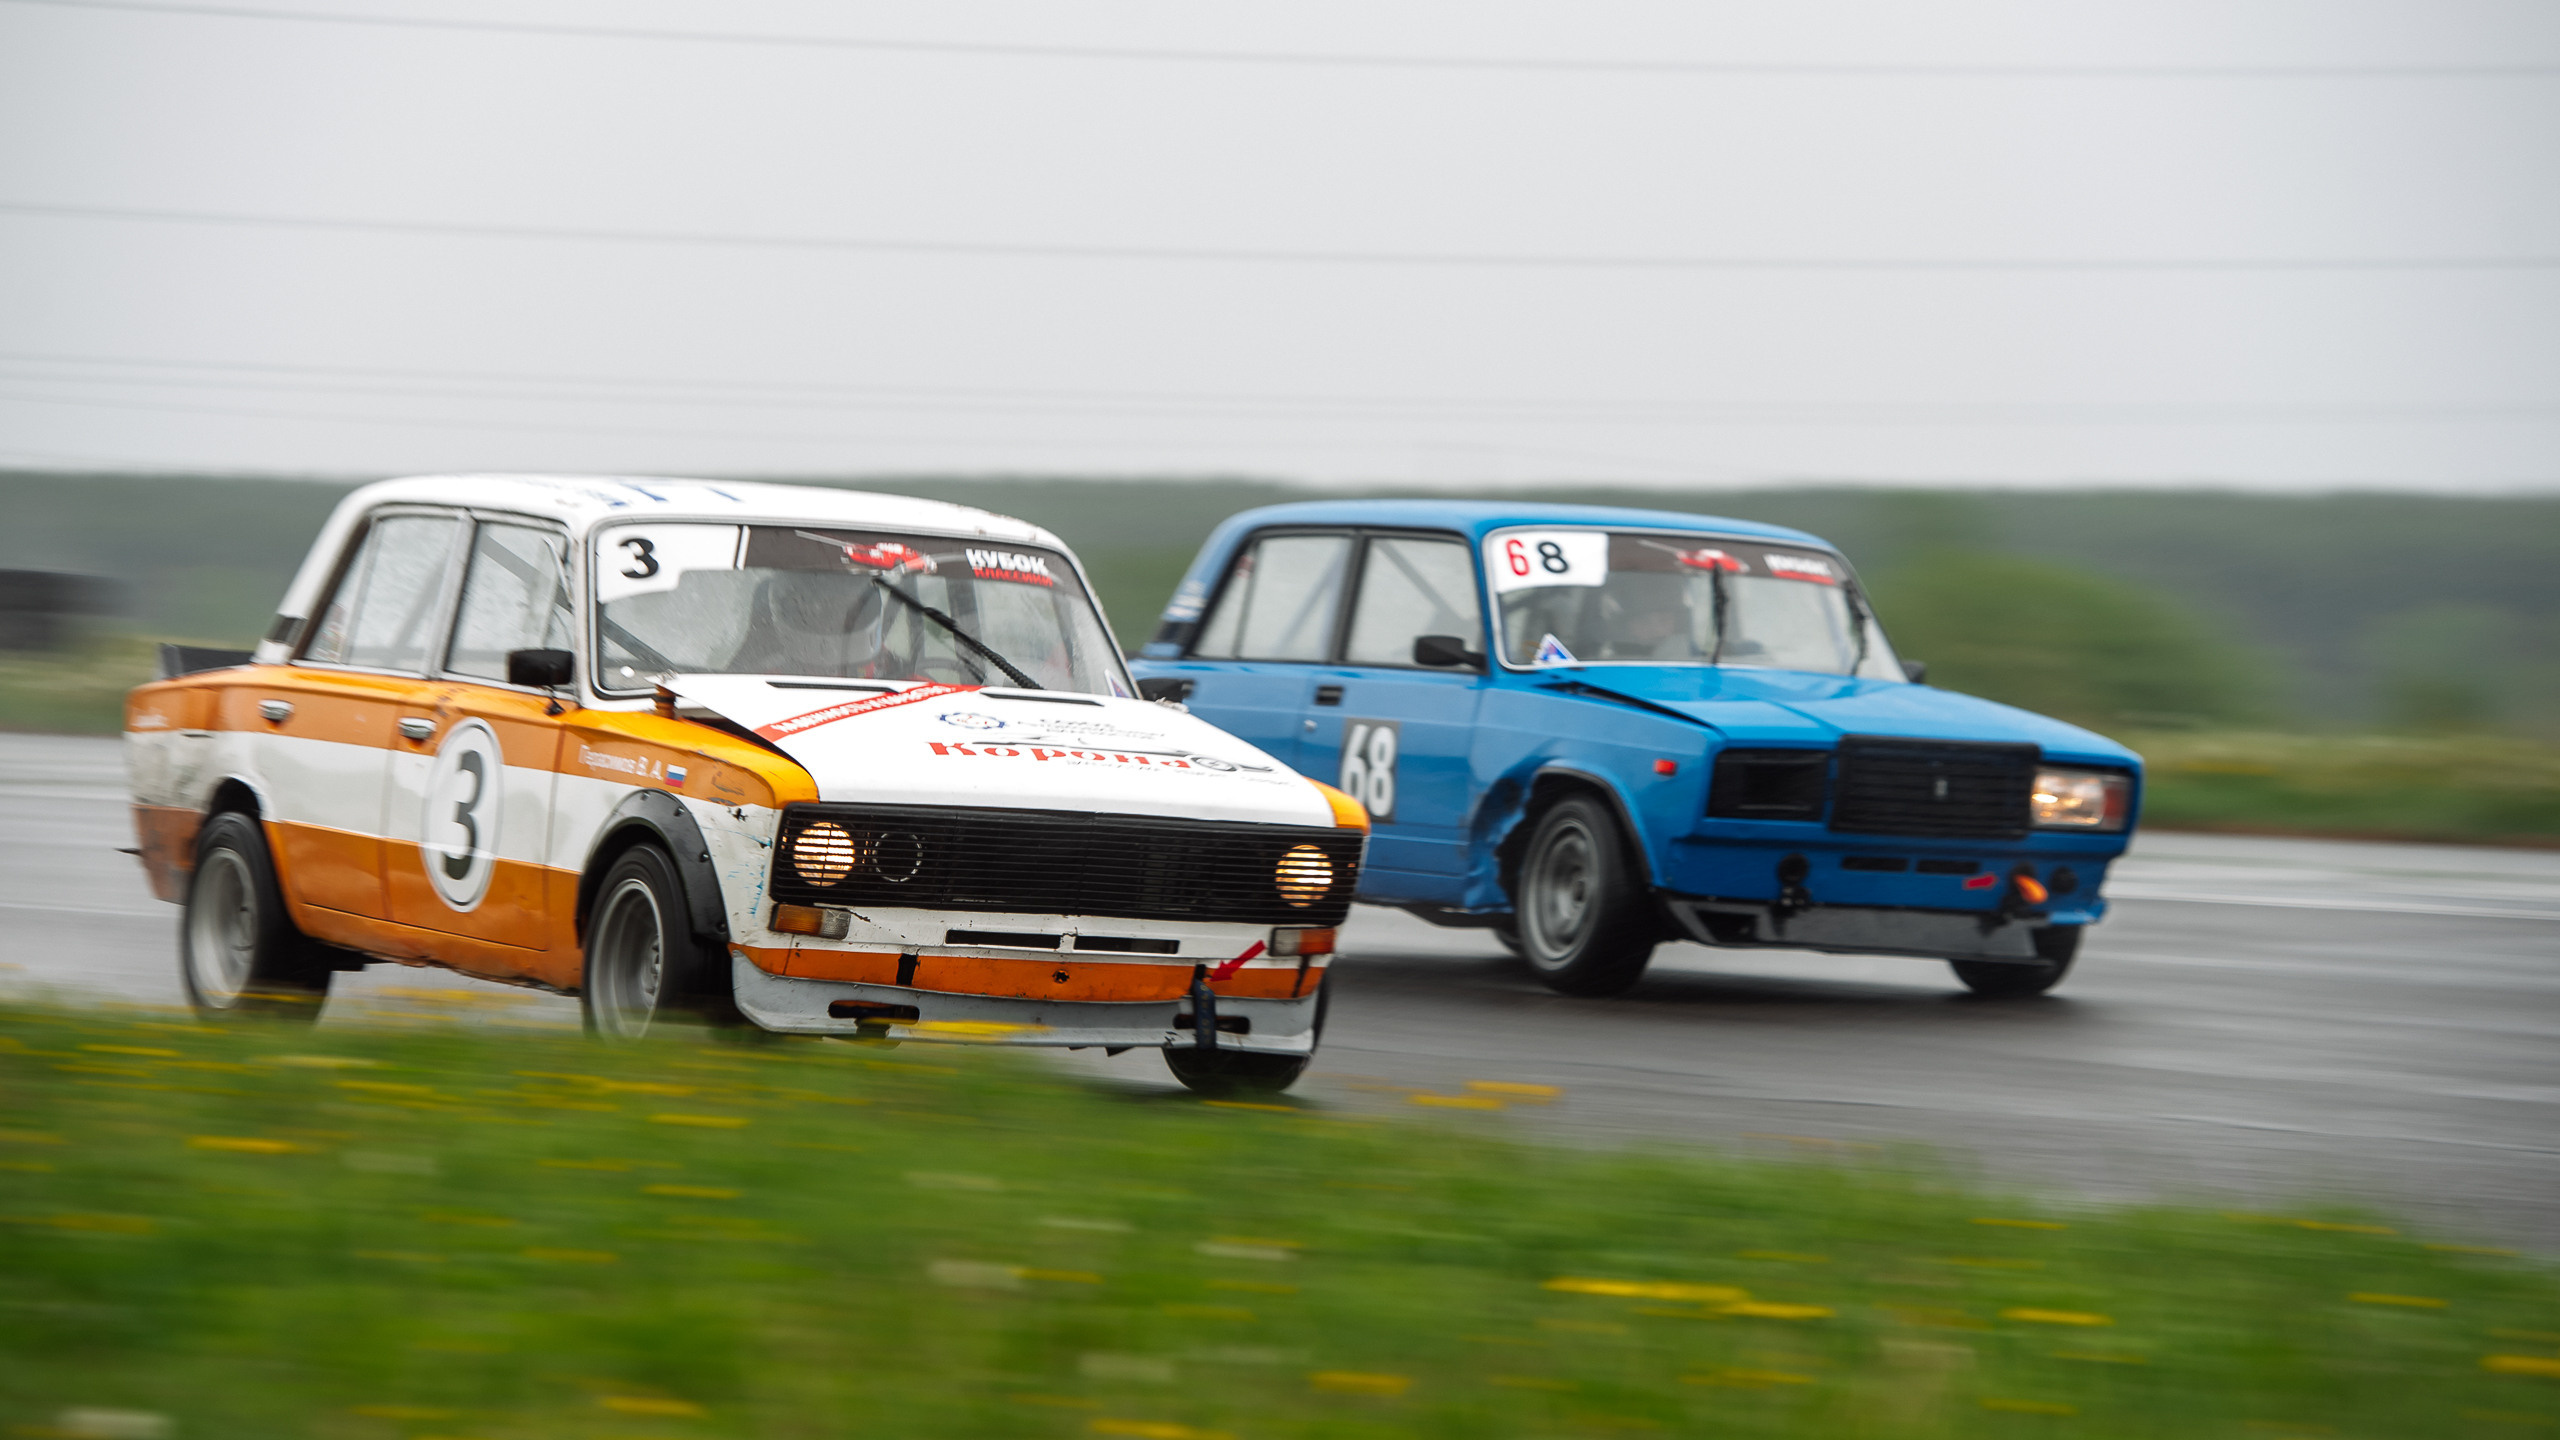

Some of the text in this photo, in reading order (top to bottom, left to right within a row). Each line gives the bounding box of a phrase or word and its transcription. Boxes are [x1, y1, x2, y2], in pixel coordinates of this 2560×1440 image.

[618, 537, 659, 579] 3
[965, 548, 1050, 577] КУБОК
[1505, 539, 1570, 577] 68
[928, 741, 1191, 769] Корона
[1340, 724, 1397, 817] 68
[444, 750, 484, 880] 3
